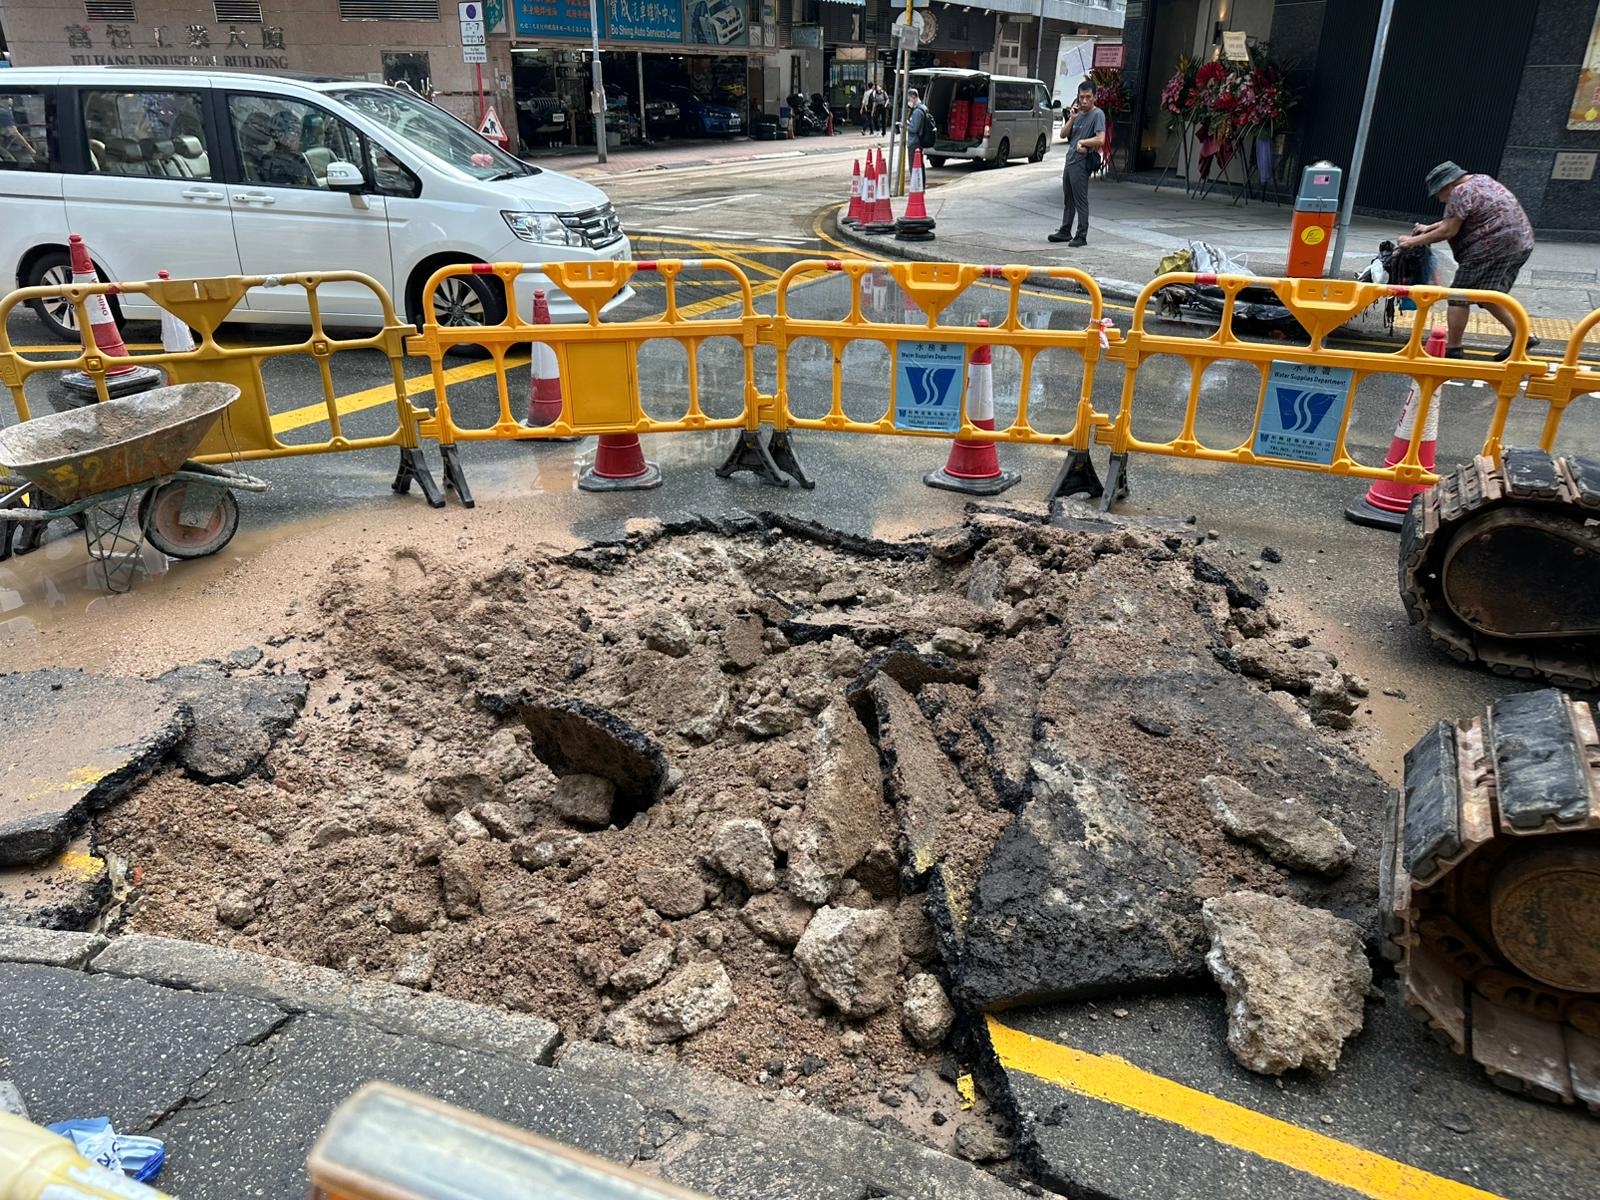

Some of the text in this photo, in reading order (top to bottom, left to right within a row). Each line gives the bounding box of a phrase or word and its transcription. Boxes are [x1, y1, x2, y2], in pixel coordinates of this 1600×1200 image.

[619, 24, 634, 38] Shing
[634, 25, 646, 37] Auto
[477, 34, 484, 43] 12
[94, 55, 136, 66] HANG
[139, 55, 218, 68] INDUSTRIAL
[224, 56, 288, 69] BUILDING
[1290, 373, 1313, 382] Supplies
[1313, 376, 1346, 385] Department
